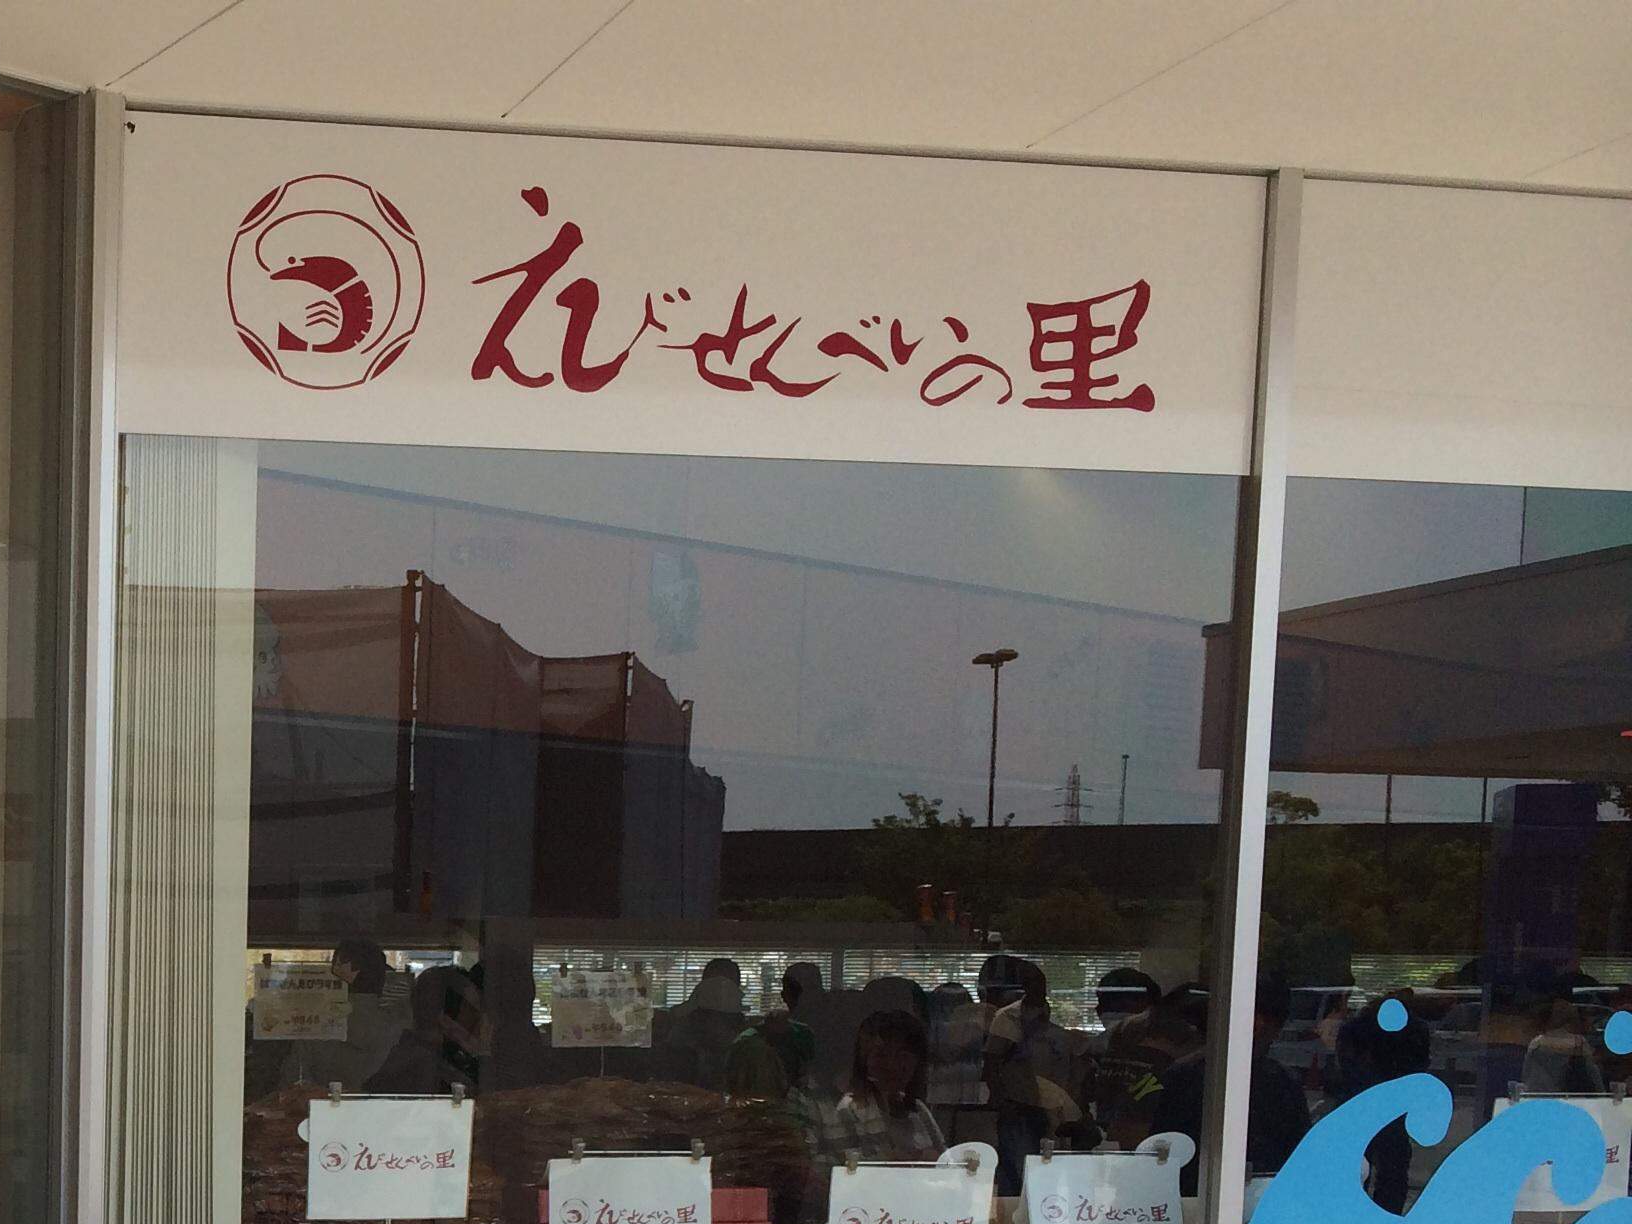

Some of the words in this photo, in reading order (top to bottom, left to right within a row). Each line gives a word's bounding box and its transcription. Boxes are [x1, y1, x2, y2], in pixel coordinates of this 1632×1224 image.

[472, 186, 1156, 413] えびせんべいの里
